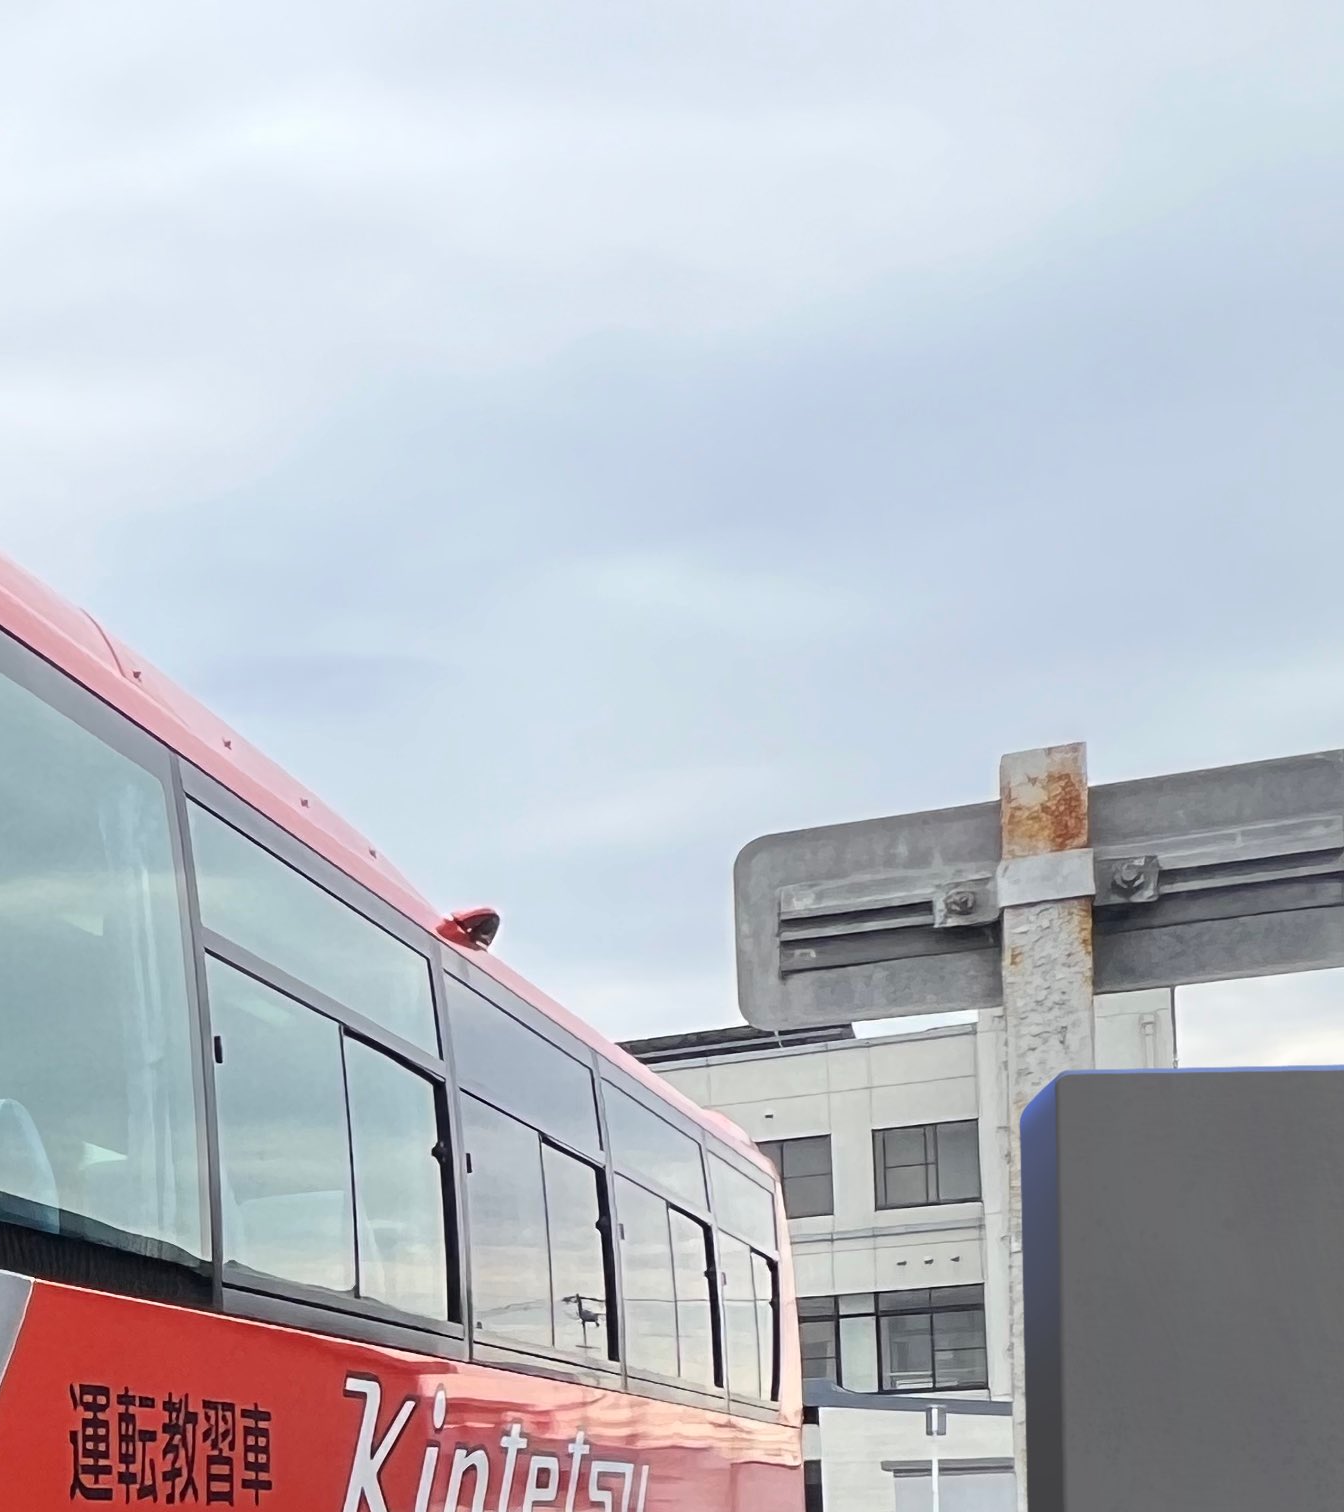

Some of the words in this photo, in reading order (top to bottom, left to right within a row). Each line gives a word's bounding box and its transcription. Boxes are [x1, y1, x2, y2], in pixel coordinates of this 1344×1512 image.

[69, 1383, 273, 1506] 運転教習車
